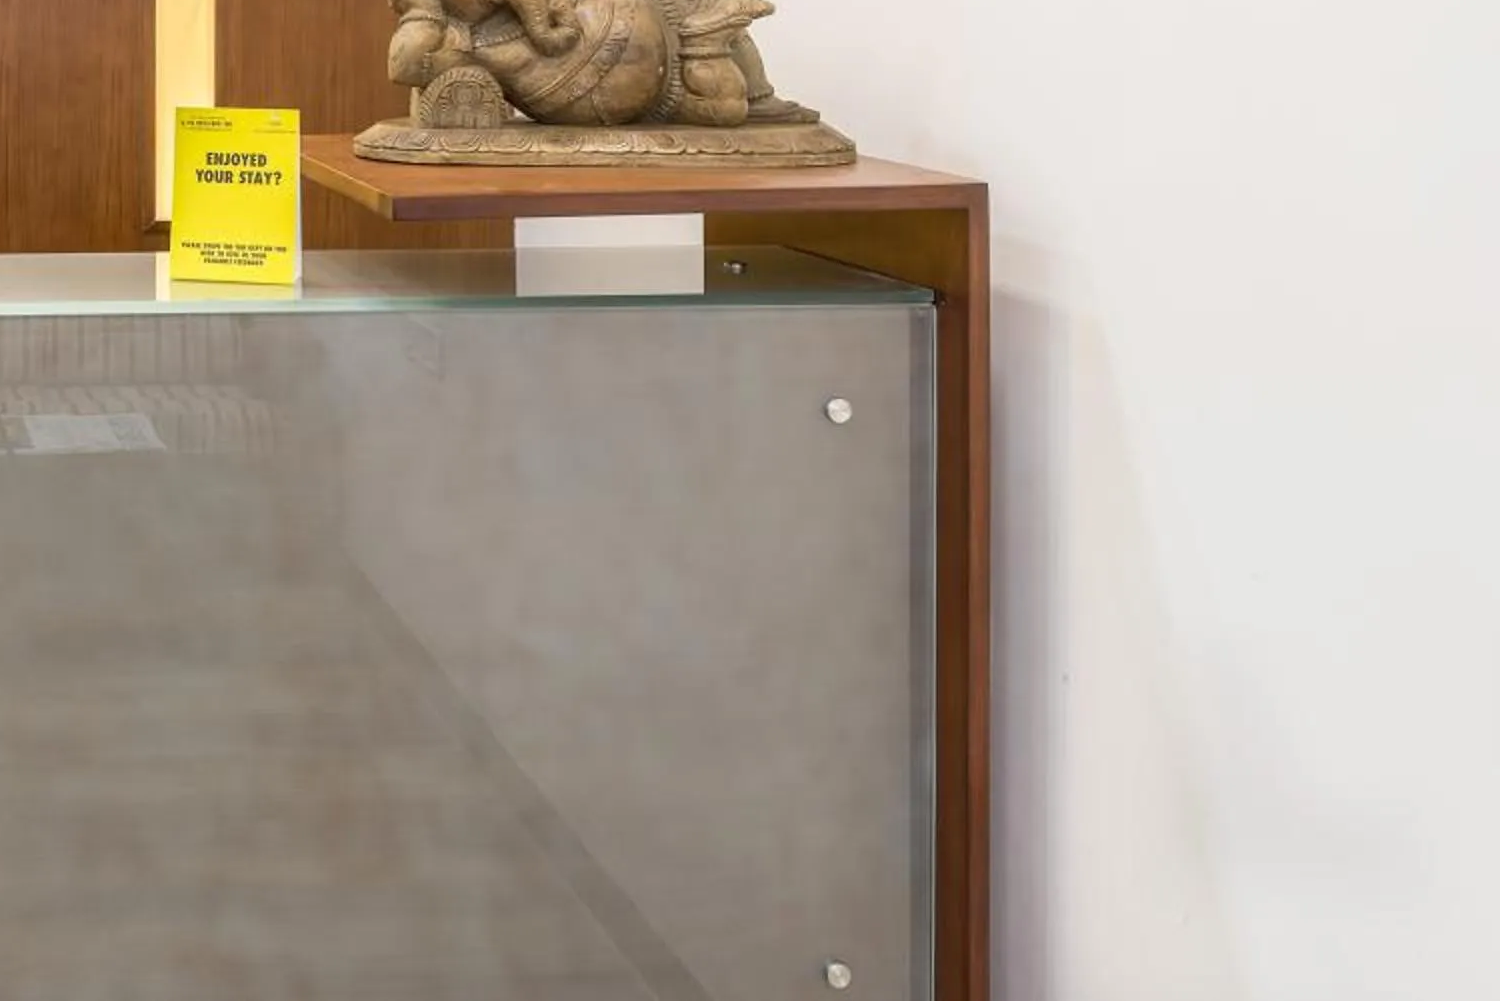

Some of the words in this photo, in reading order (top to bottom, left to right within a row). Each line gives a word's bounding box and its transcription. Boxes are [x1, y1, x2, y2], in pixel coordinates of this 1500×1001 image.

[206, 152, 267, 167] ENJOYED
[196, 169, 233, 184] YOUR
[239, 171, 282, 186] STAY?
